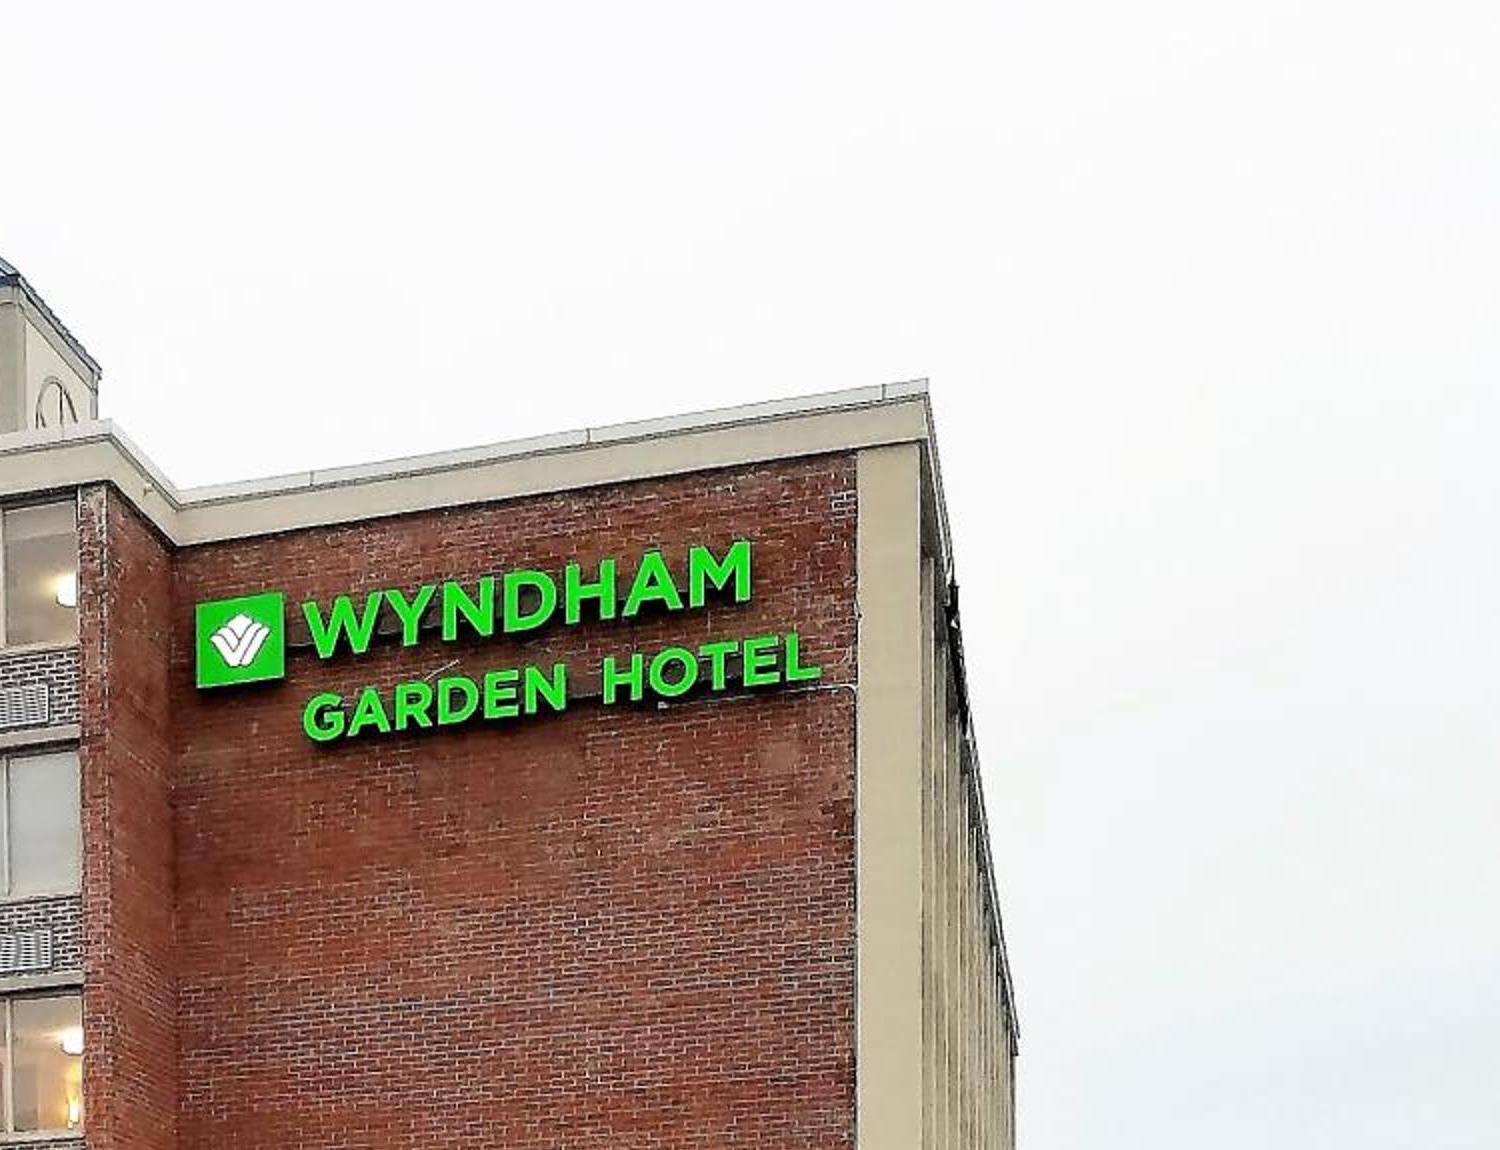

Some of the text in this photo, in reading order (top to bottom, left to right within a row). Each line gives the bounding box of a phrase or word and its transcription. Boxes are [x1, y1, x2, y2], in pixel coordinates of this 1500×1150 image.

[303, 540, 752, 658] WYNDHAM
[303, 632, 821, 741] GARDEN HOTEL
